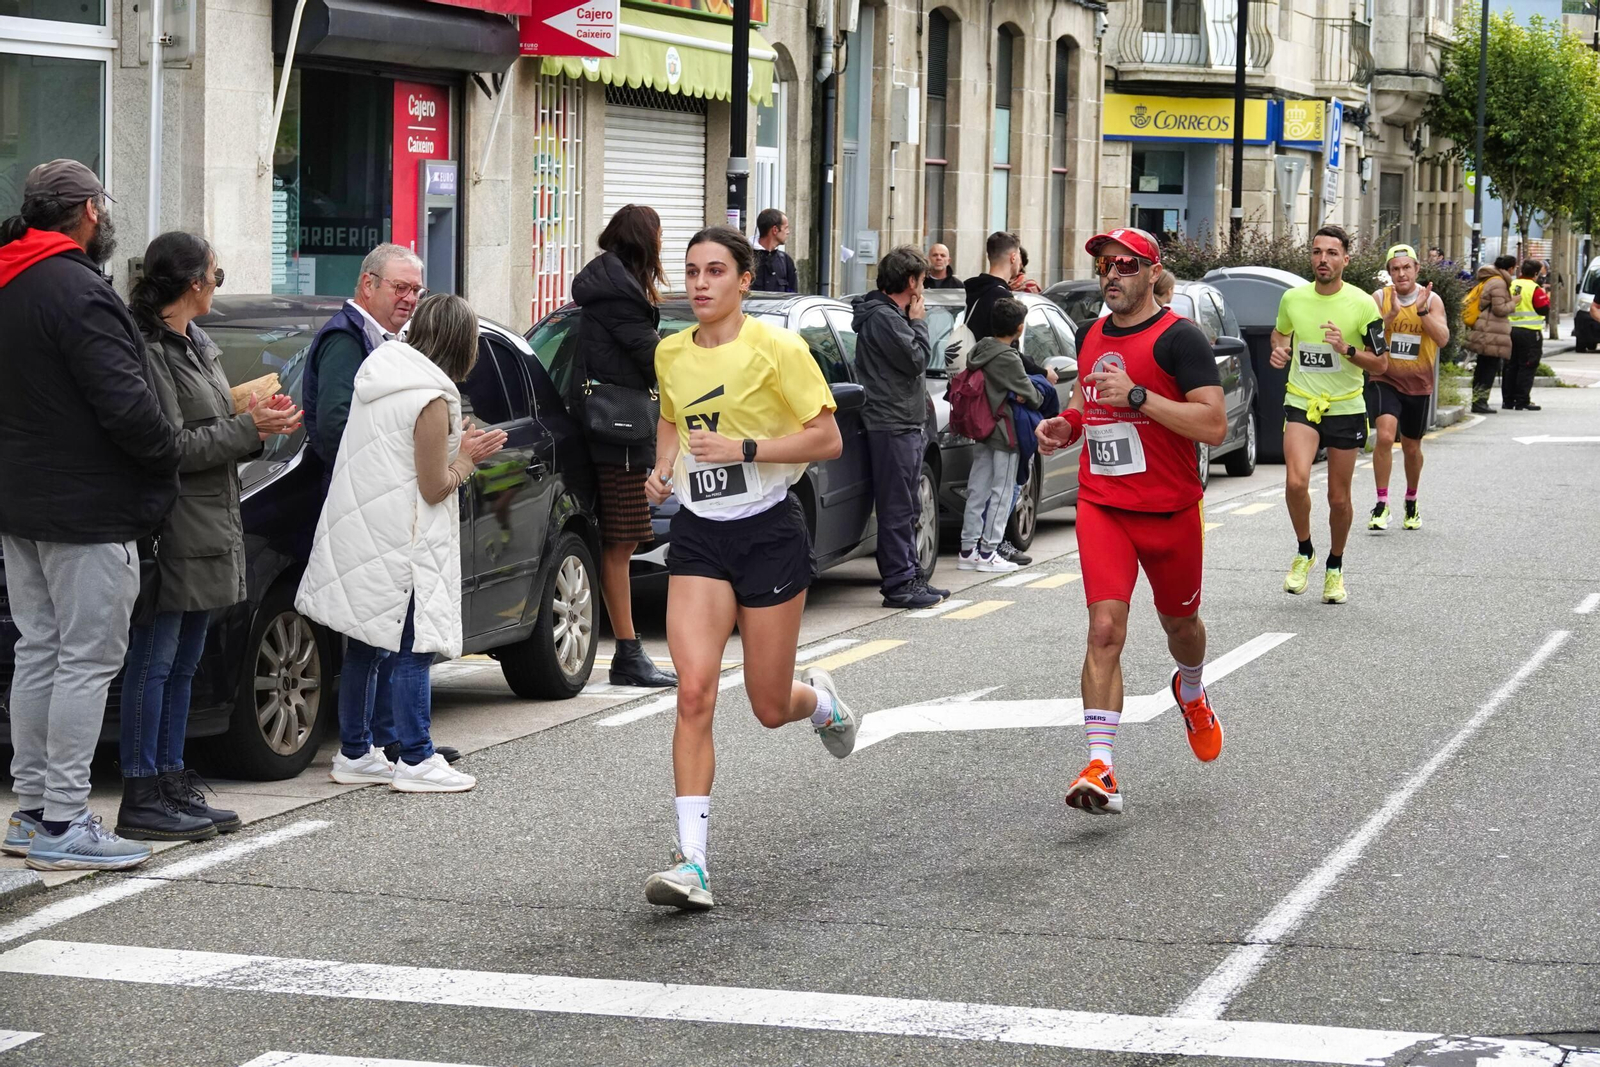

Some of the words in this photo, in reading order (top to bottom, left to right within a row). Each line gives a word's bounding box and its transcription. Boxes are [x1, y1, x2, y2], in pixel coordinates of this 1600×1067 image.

[576, 8, 613, 22] Cajero
[576, 29, 612, 39] Caixeiro
[408, 94, 436, 122] Cajero
[1331, 107, 1341, 160] P
[407, 135, 434, 154] Caixeiro
[298, 226, 379, 247] ARBERÍA
[1397, 342, 1413, 353] 117
[1303, 352, 1326, 365] 254
[685, 411, 720, 433] EY
[1096, 441, 1119, 462] 661
[695, 468, 728, 494] 109
